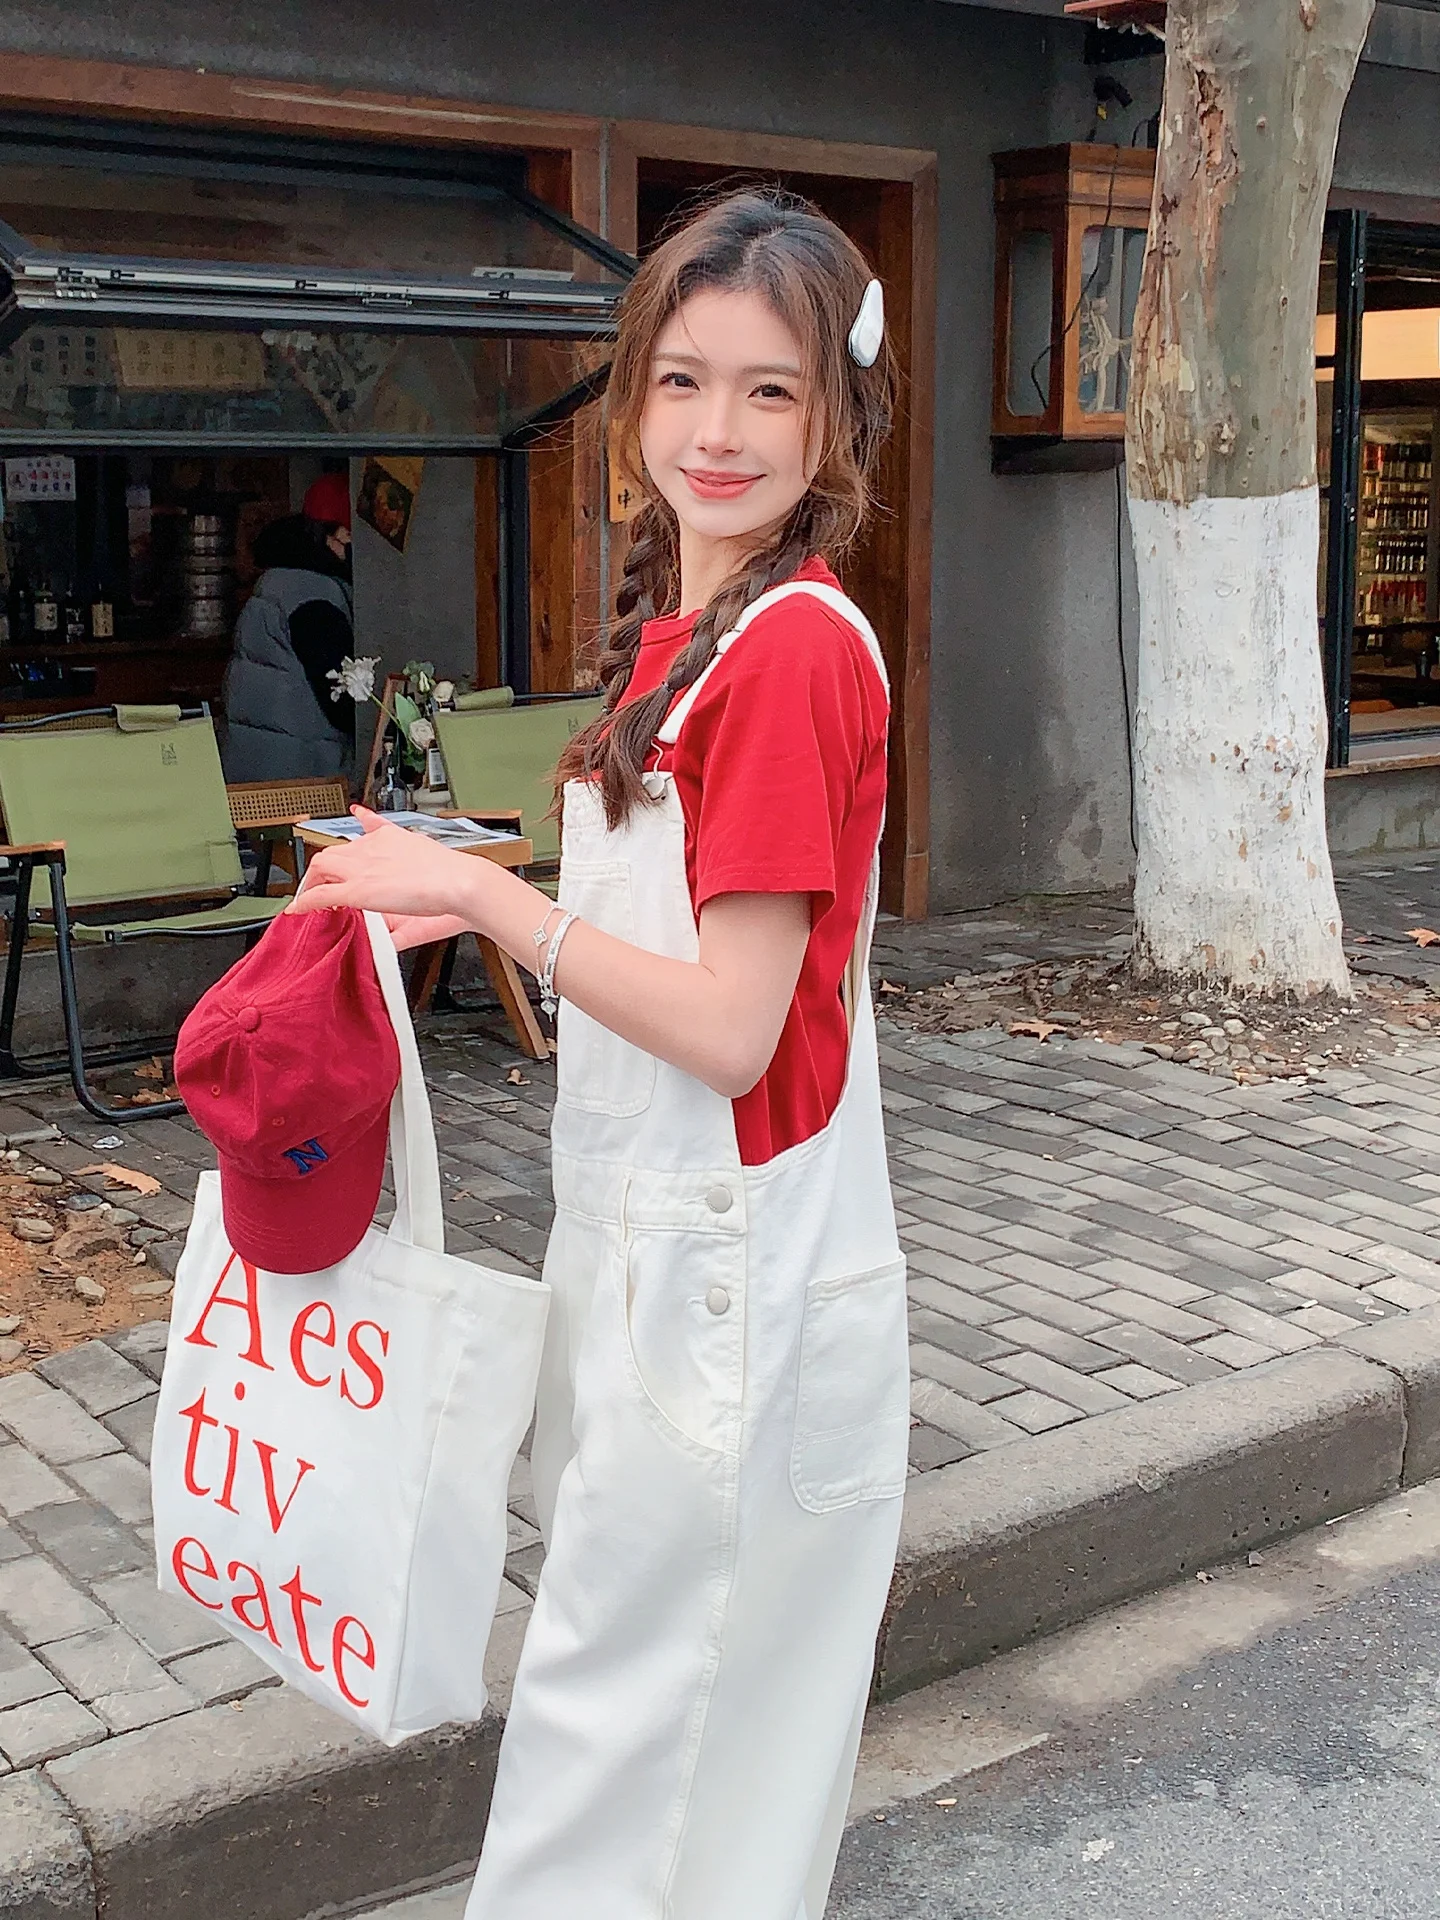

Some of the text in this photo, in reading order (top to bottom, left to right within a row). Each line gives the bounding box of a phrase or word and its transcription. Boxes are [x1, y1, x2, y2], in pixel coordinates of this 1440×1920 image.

[283, 1138, 329, 1176] N
[184, 1248, 390, 1411] Aes
[178, 1381, 315, 1534] tiv
[171, 1536, 376, 1709] eate
